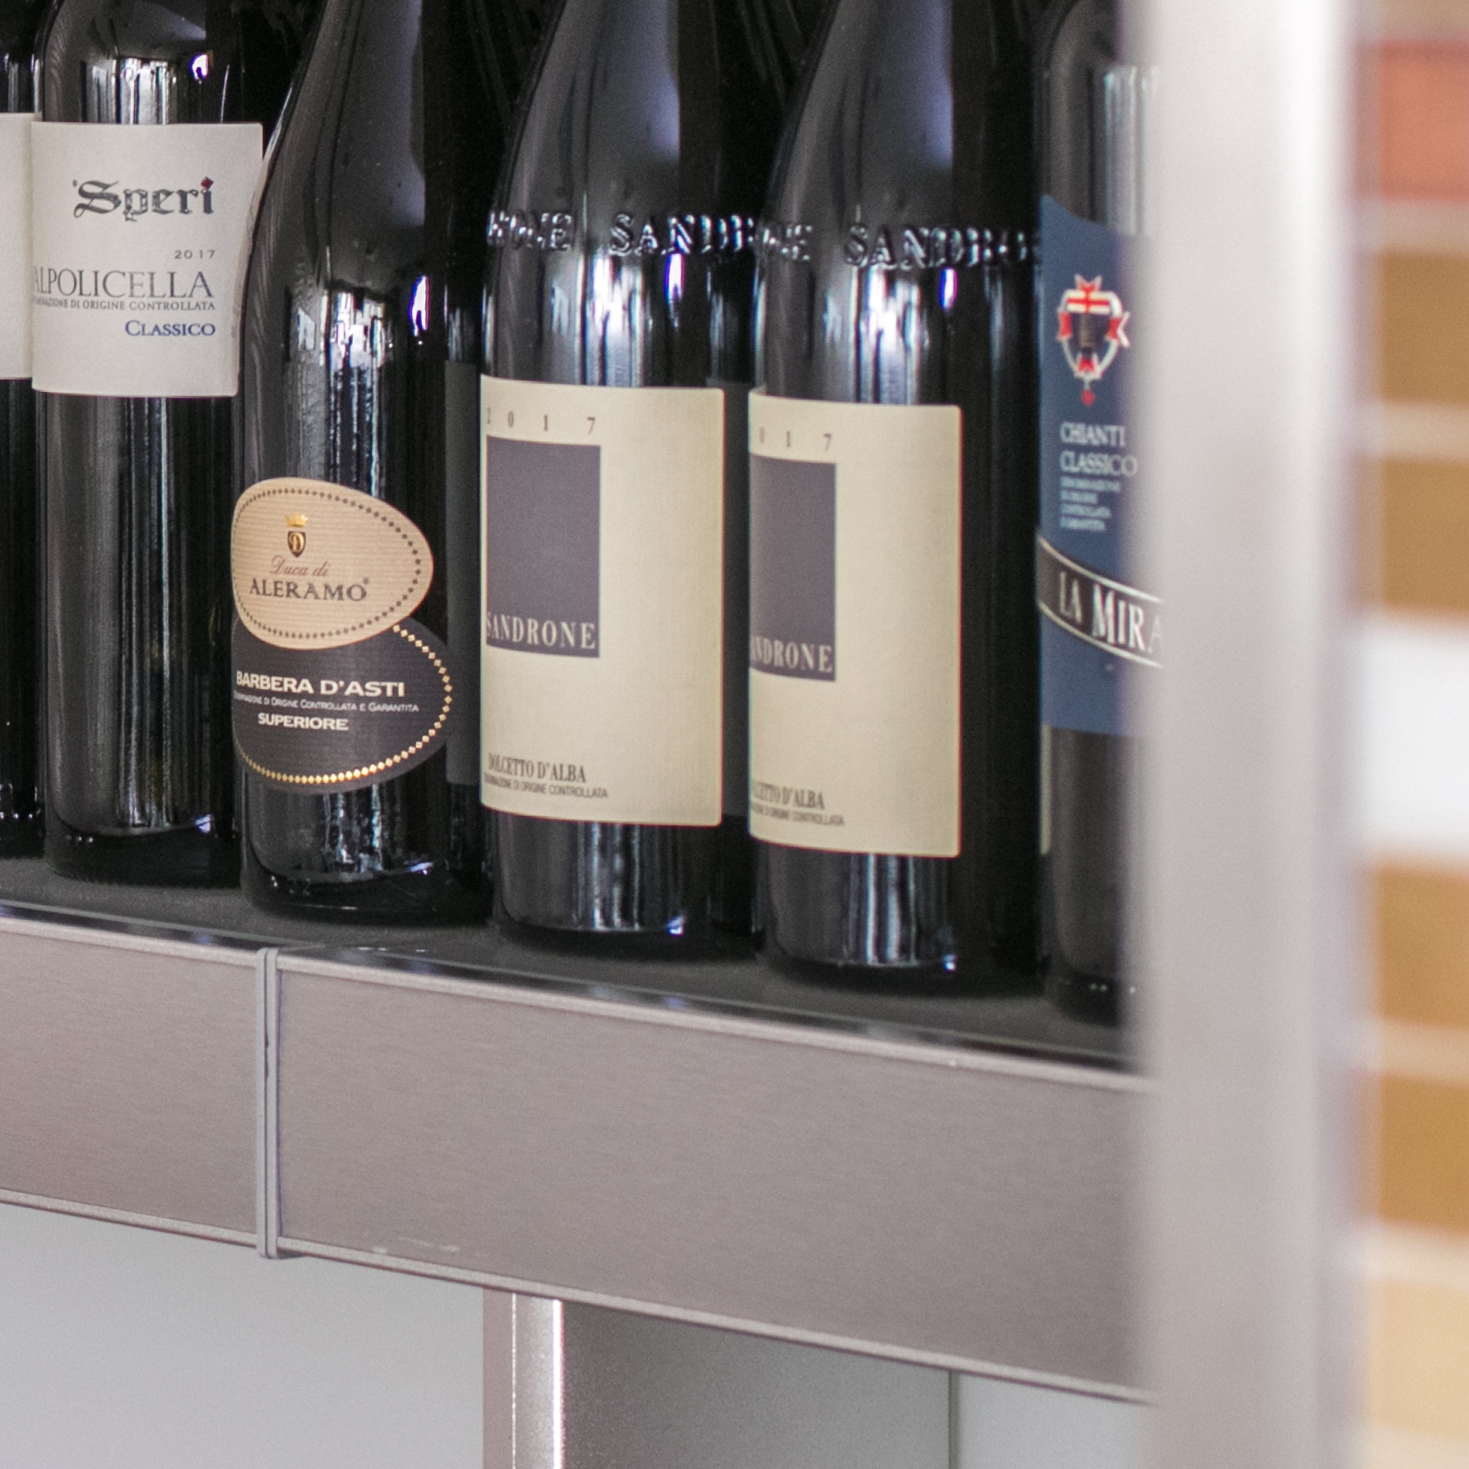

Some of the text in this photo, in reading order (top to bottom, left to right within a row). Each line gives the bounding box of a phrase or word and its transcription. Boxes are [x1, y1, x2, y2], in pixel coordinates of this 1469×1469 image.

[73, 176, 215, 223] Speri
[174, 249, 216, 260] 2017
[33, 266, 215, 299] ALPOLICELLA
[71, 299, 81, 310] DI
[82, 300, 126, 311] ORIGINE
[128, 300, 216, 312] CONTROLLATA
[125, 319, 217, 337] CLASSICO
[1060, 421, 1126, 448] CHIANTI
[1059, 449, 1138, 478] CLASSICO
[269, 554, 332, 578] Duca di
[249, 577, 368, 602] ALERAMO
[1059, 570, 1082, 624] LA
[486, 611, 597, 650] SANDRONE
[236, 670, 405, 697] BARBERA D'ASTI
[300, 698, 358, 712] CONTROLLATA
[359, 702, 366, 712] E
[368, 701, 420, 712] GARANTITA
[257, 712, 350, 731] SUPERIORE
[536, 760, 587, 784] D'ALBA
[548, 783, 609, 799] CONTROLLATA
[782, 786, 825, 810] D'ALBA
